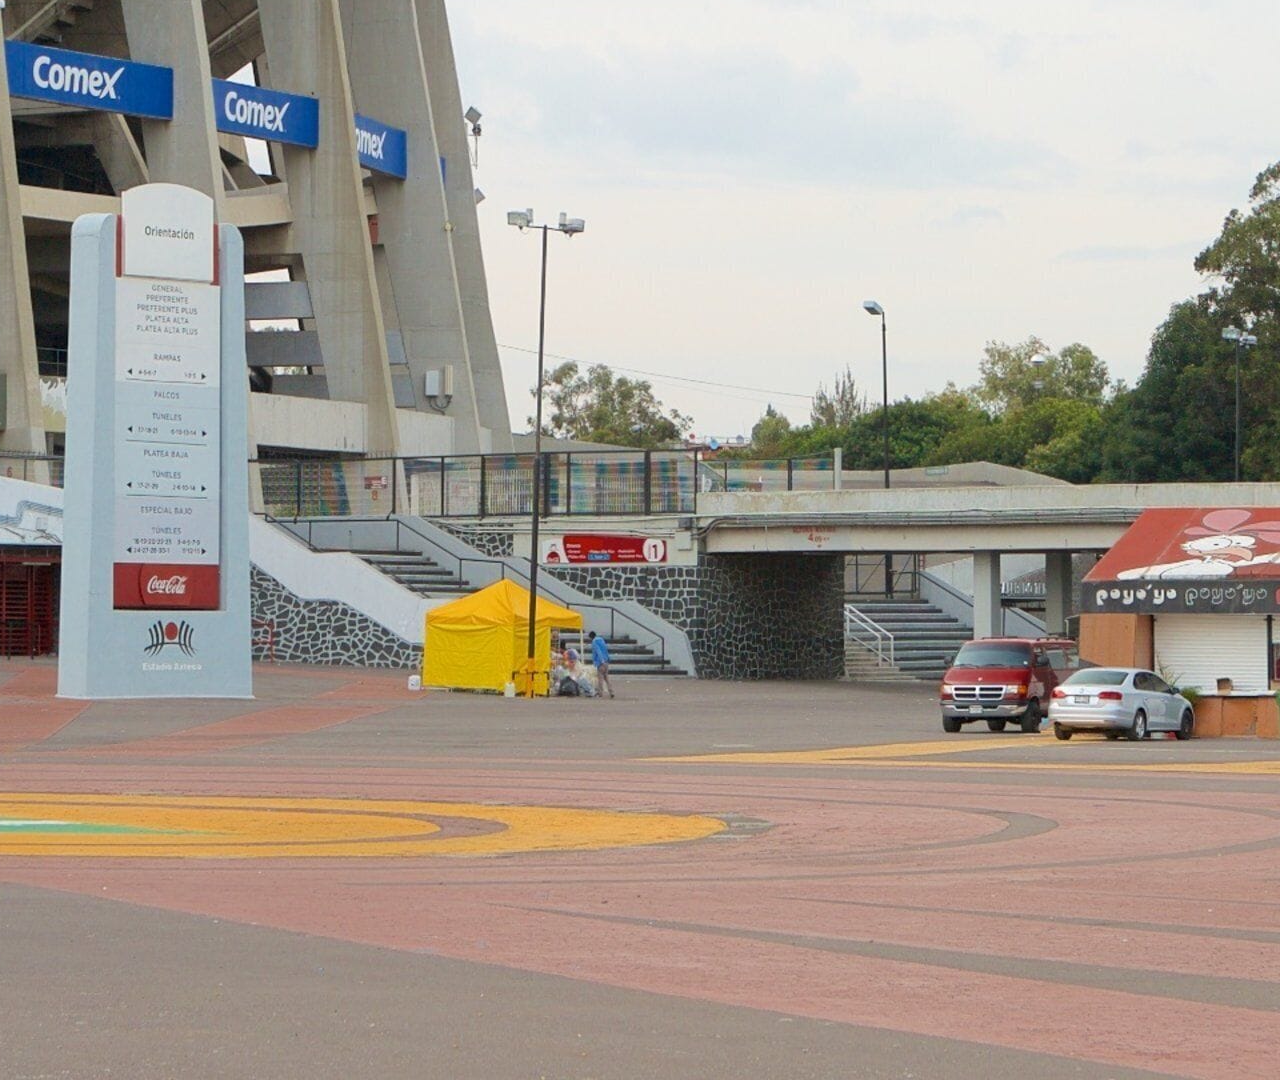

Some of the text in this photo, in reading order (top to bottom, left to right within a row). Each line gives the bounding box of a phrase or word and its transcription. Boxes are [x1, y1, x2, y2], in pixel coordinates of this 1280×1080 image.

[32, 55, 124, 99] Comex
[224, 91, 290, 132] Comex
[144, 225, 195, 240] Orientación
[151, 284, 184, 294] GENERAL
[145, 294, 189, 304] PREFERENTE
[136, 303, 198, 316] PREFERENTE PLUS
[145, 315, 190, 325] PLATEA ALTA
[136, 324, 199, 336] PLATEA ALTA PLUS
[153, 353, 182, 363] RAMPAS
[153, 390, 180, 400] PALCOS
[143, 449, 189, 459] PLATEA BAJA
[140, 506, 193, 516] ESPECIAL BAJO
[142, 662, 203, 672] Estadio Azteca
